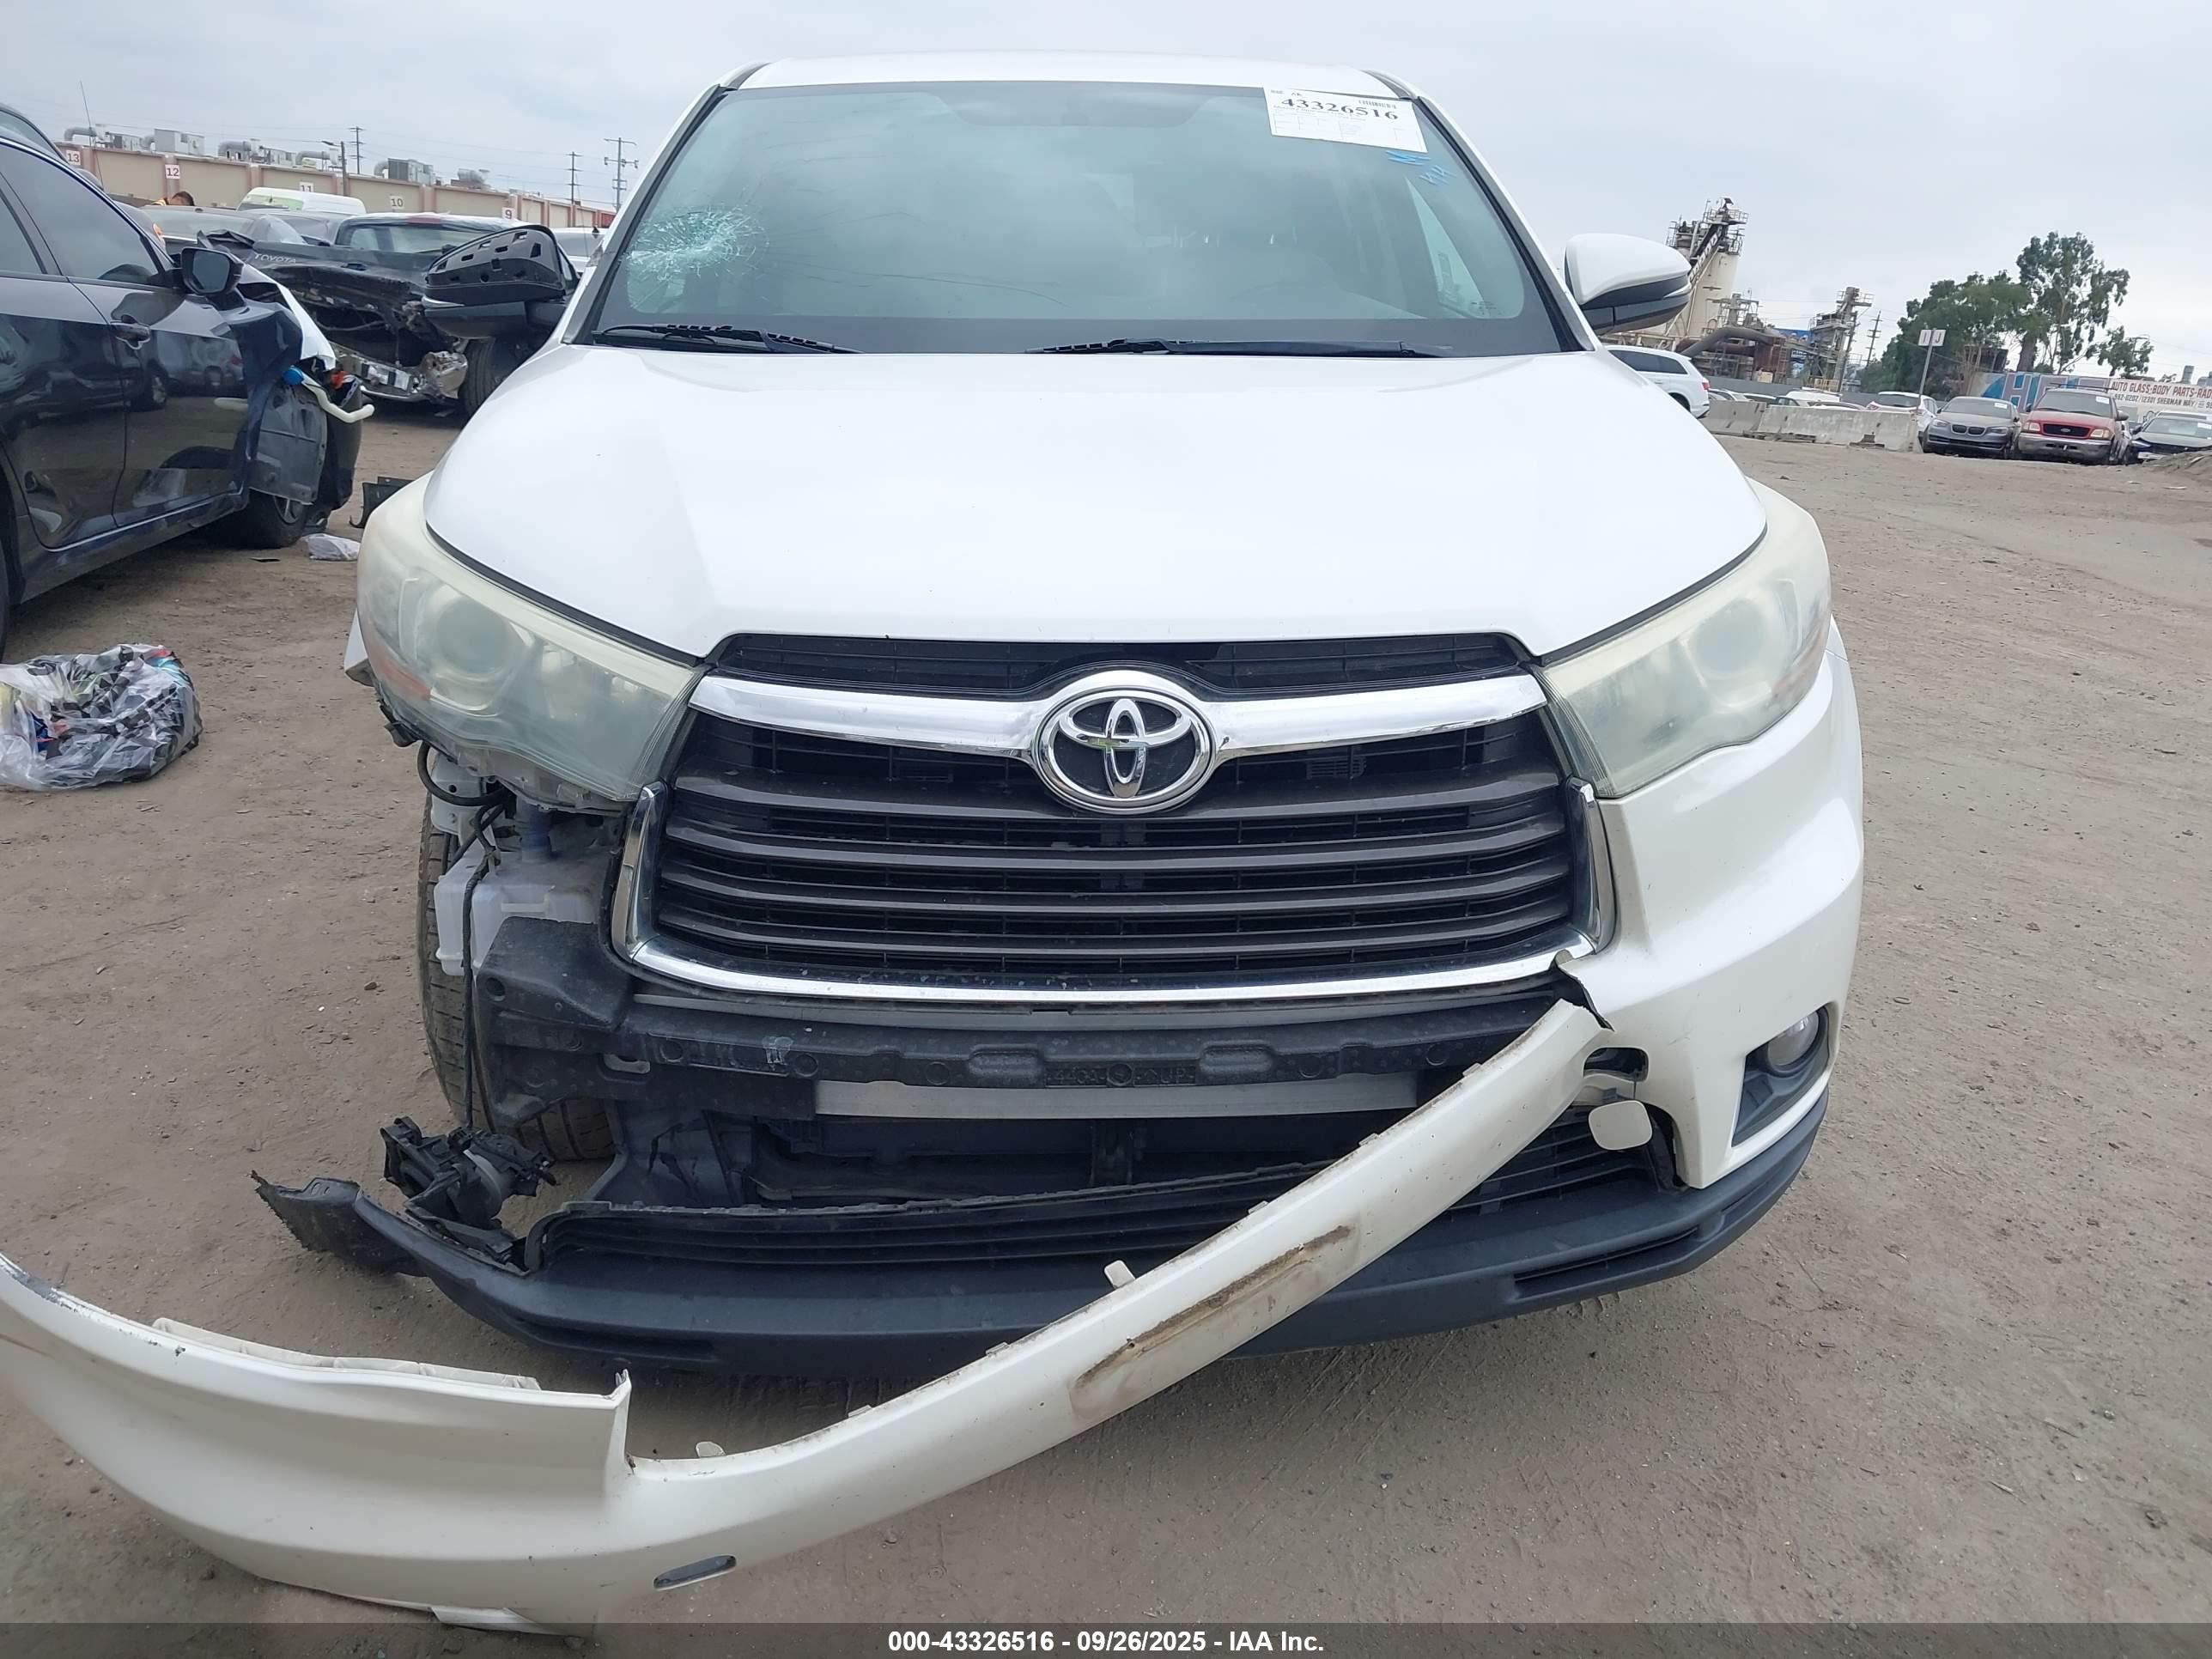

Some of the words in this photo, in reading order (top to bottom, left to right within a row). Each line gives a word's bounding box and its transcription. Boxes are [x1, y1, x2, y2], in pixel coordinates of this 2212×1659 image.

[1281, 98, 1399, 120] 43326516
[67, 153, 80, 163] 13
[167, 167, 179, 177] 12
[391, 198, 404, 207] 10
[505, 210, 513, 220] 9
[254, 252, 296, 264] TOYOTA
[2111, 381, 2128, 392] AUTO
[2156, 397, 2182, 406] SHERMAN
